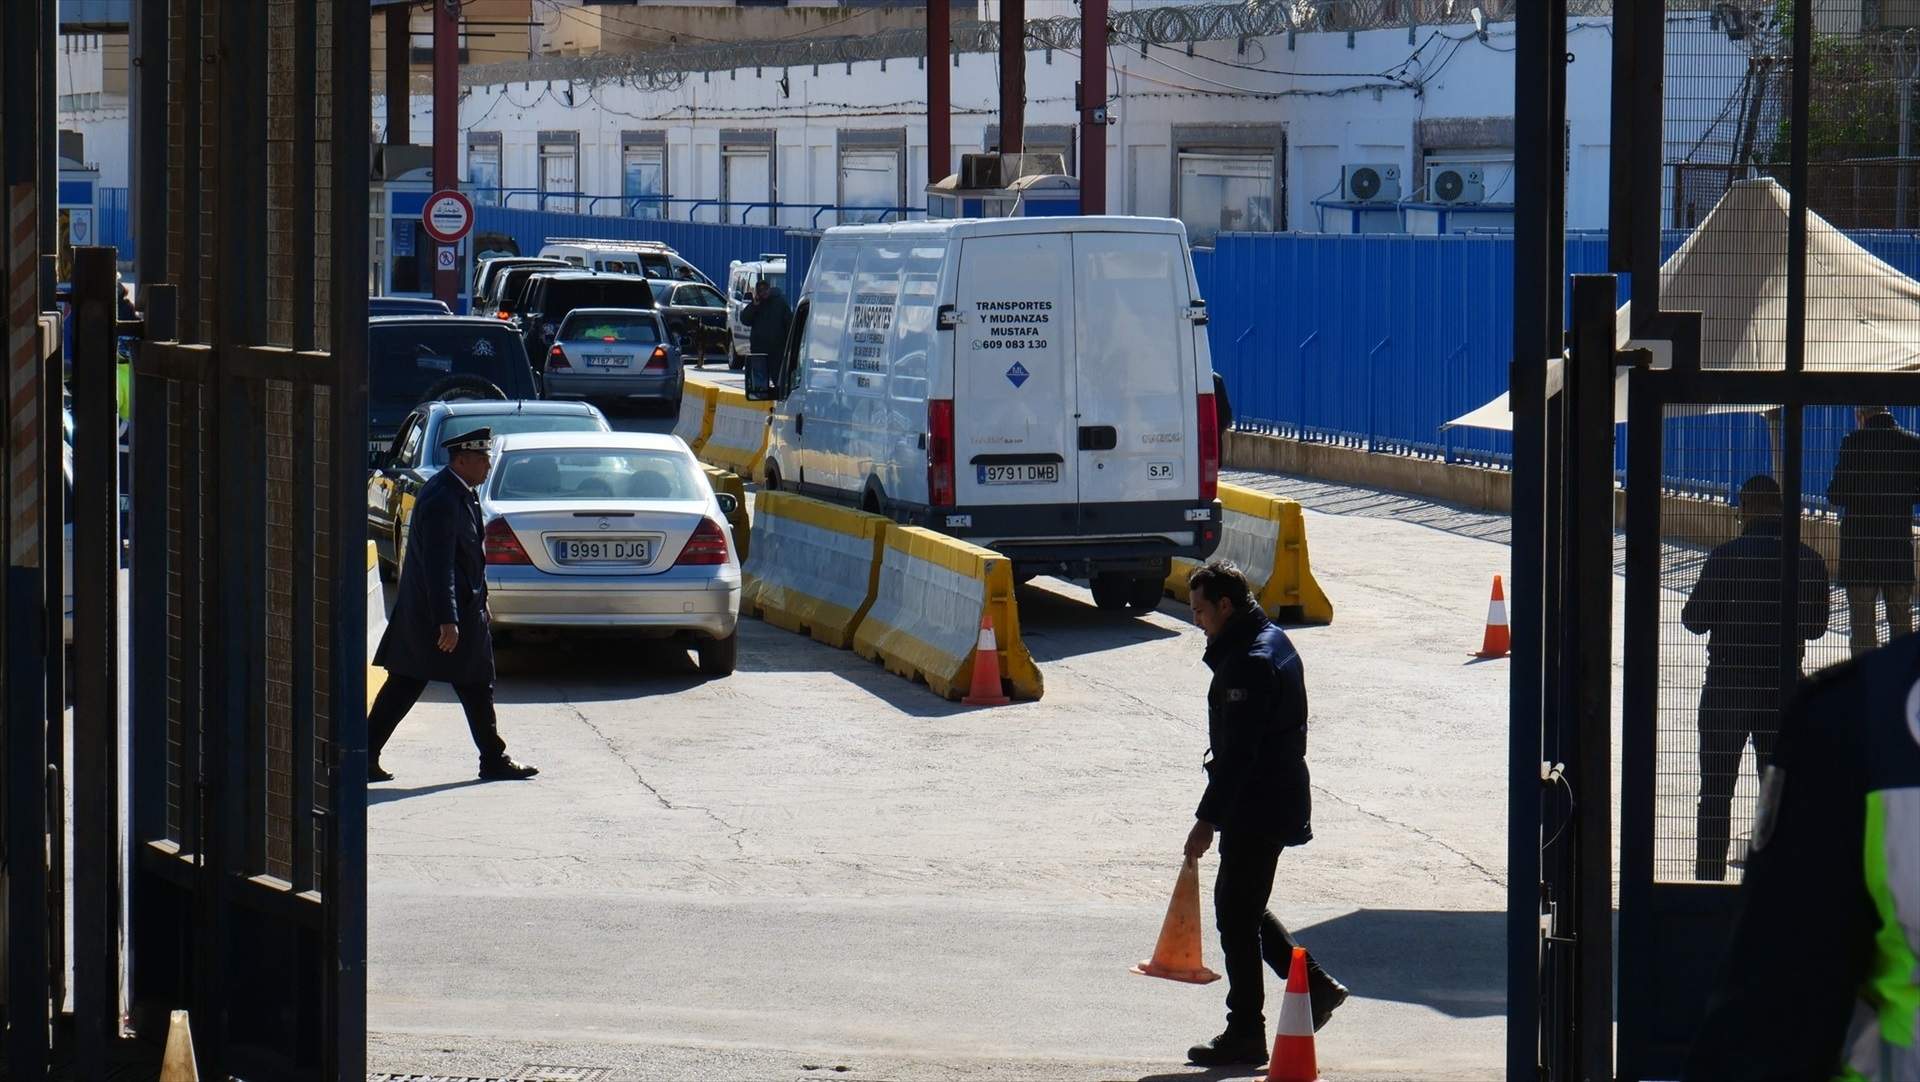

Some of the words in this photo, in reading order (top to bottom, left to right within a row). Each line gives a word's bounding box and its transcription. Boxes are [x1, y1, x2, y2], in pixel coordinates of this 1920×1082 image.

[976, 302, 1052, 310] TRANSPORTES
[852, 305, 893, 330] TRANSPORTES
[980, 315, 986, 323] Y
[990, 314, 1049, 323] MUDANZAS
[991, 327, 1039, 336] MUSTAFA
[983, 340, 1002, 349] 609
[1005, 340, 1025, 349] 083
[1028, 340, 1047, 349] 130
[988, 465, 1022, 480] 9791
[1028, 464, 1055, 480] DMB
[1149, 465, 1172, 477] S.P.
[570, 543, 608, 557] 9991
[615, 543, 645, 557] DJG
